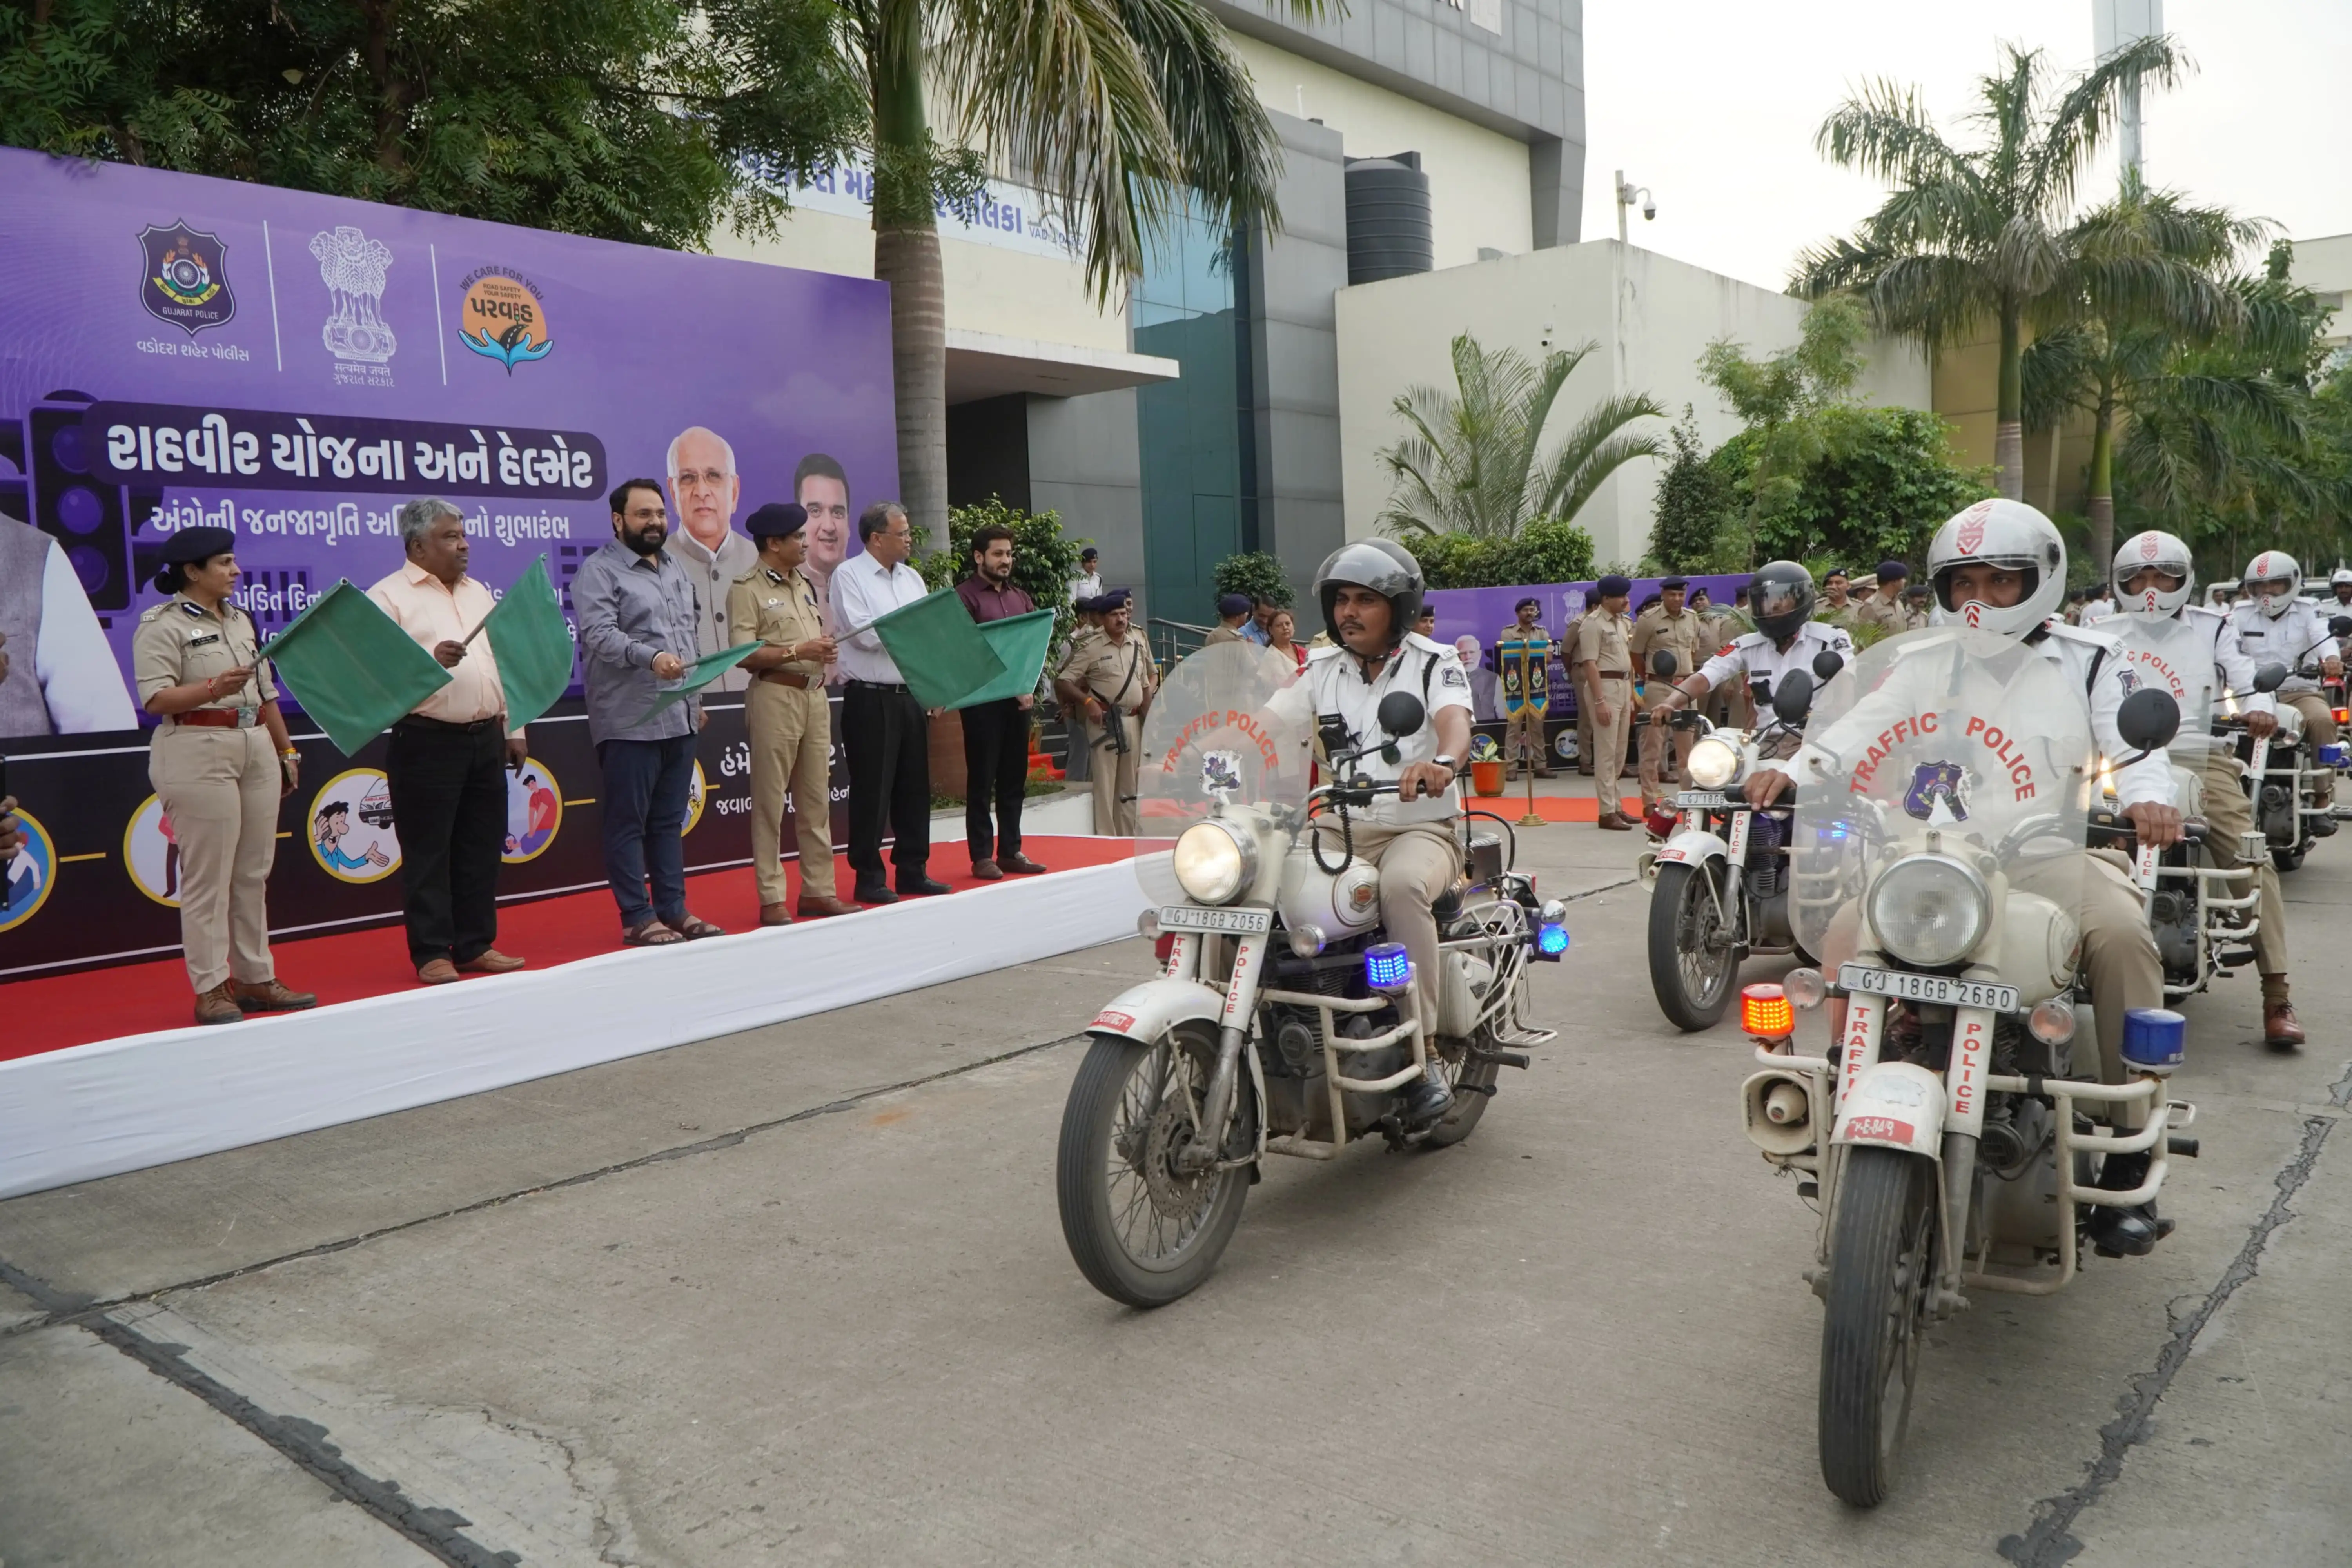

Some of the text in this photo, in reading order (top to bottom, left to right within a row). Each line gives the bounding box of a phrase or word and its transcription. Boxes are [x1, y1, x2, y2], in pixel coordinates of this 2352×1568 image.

[460, 266, 544, 300] WE CARE FOR YOU
[162, 307, 219, 320] GUJARAT POLICE
[137, 337, 249, 361] વડોદરા શહેર પોલીસ
[334, 361, 391, 377] सत्यमेव जयते
[332, 373, 395, 387] ગુજરાત સરકાર
[107, 413, 593, 488] રાહવીર યોજના અને હેલ્મેટ
[242, 503, 360, 546] જનજાગૃતિ
[495, 509, 570, 547] શુભારંભ
[2141, 652, 2185, 699] POLICE
[1163, 709, 1279, 773] TRAFFIC POLICE
[1849, 712, 2036, 802] TRAFFIC POLICE
[1688, 795, 1698, 804] GJ
[1731, 812, 1744, 854] POLICE
[1174, 909, 1264, 930] GJ 18GB 2056
[1167, 937, 1186, 978] TRAF
[1225, 946, 1249, 1014] POLICE
[1862, 971, 2010, 1008] GJ 18GB 2680
[1955, 1022, 1982, 1114] POLICE
